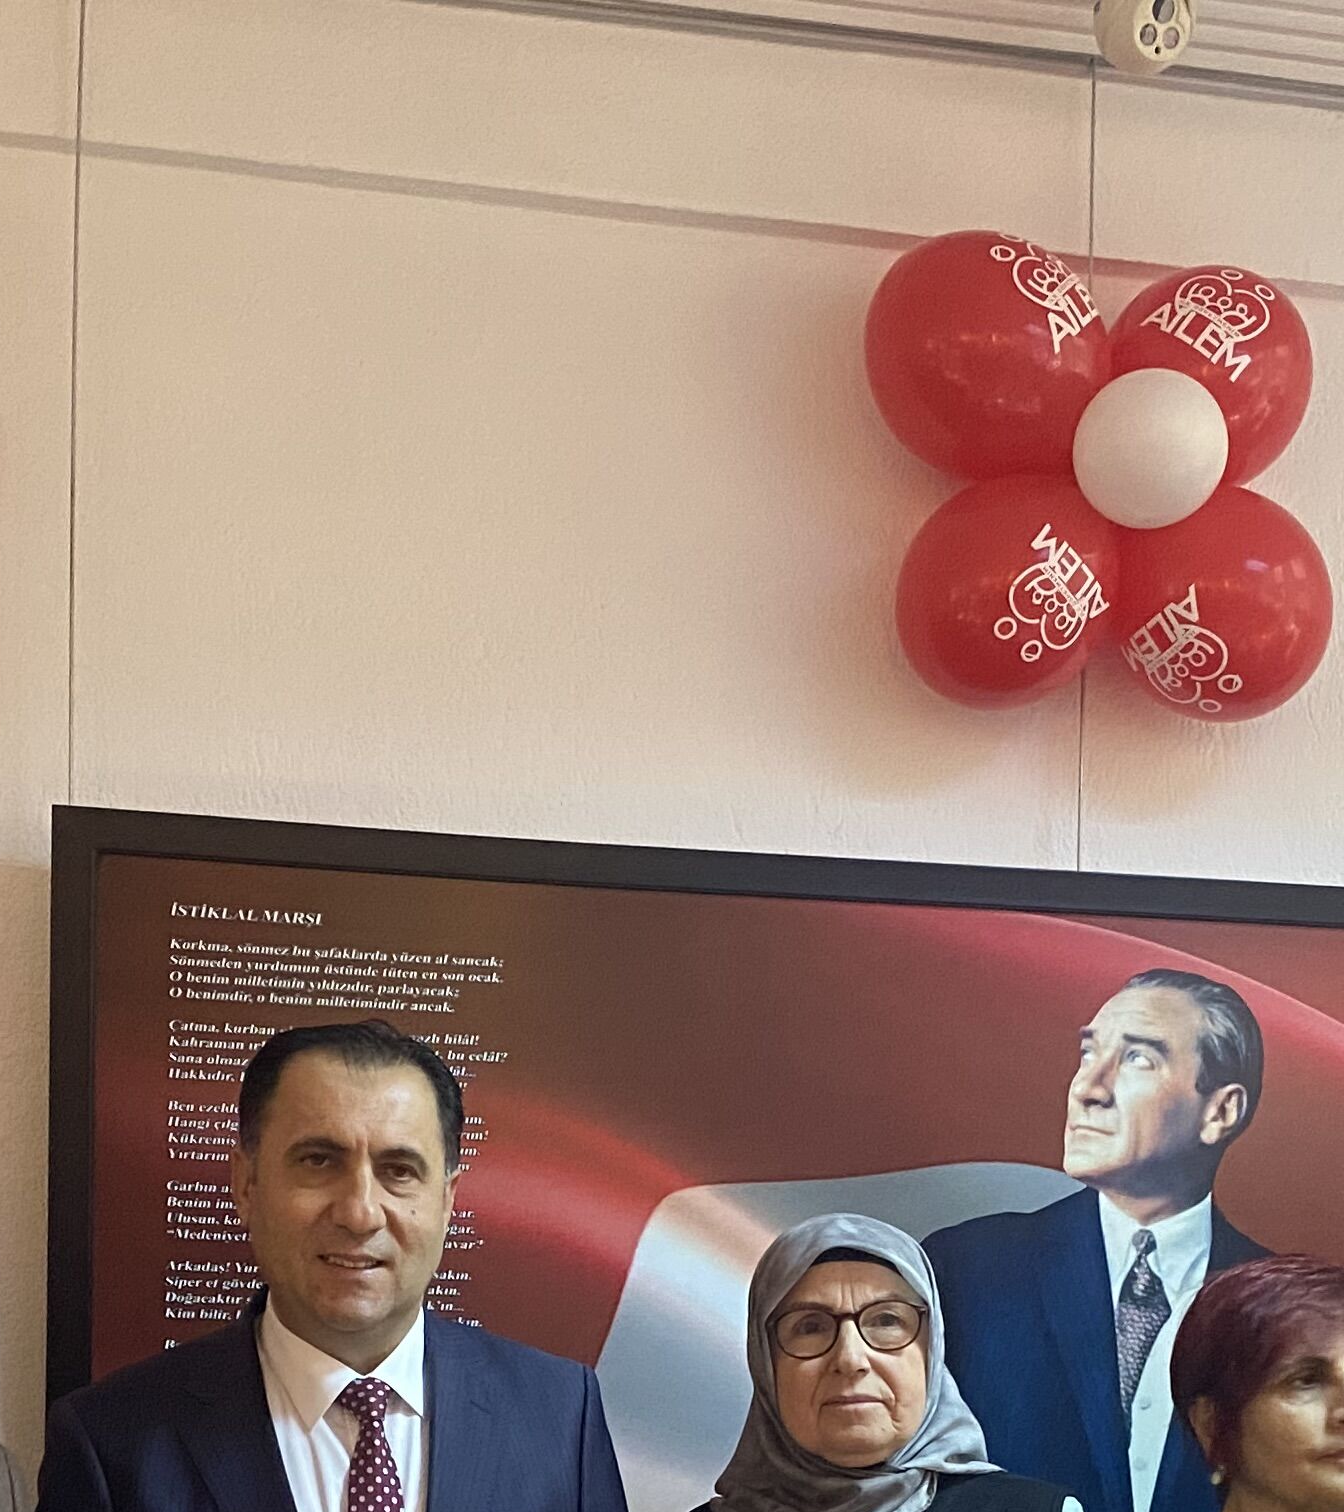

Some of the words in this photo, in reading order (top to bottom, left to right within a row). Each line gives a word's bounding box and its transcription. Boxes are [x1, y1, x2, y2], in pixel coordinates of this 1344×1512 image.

[262, 909, 323, 928] MARŞI
[236, 943, 290, 956] sönmez
[292, 945, 310, 957] bu
[314, 945, 387, 962] şafaklarda
[391, 951, 431, 963] yüzen
[435, 954, 449, 965] al
[169, 954, 242, 969] Sönmeden
[245, 960, 320, 973] yurdumun
[324, 963, 379, 977] üstünde
[382, 968, 418, 979] tüten
[421, 971, 438, 980] en
[442, 972, 465, 982] son
[169, 970, 183, 982] O
[186, 972, 230, 984] benim
[234, 974, 305, 989] milletimin
[169, 986, 183, 998] O
[256, 994, 265, 1003] o
[269, 992, 312, 1005] benim
[316, 995, 408, 1010] milletimindir
[224, 1022, 275, 1036] kurban
[169, 1035, 244, 1051] Kahraman
[447, 1050, 465, 1061] bu
[168, 1051, 203, 1064] Sana
[206, 1054, 249, 1066] olmaz
[168, 1100, 194, 1112] Ben
[168, 1116, 210, 1130] Hangi
[214, 1118, 239, 1132] çılg
[168, 1147, 230, 1161] Yırtarım
[166, 1180, 217, 1194] Garbın
[166, 1196, 211, 1209] Benim
[166, 1260, 231, 1275] Arkadaş!
[165, 1276, 203, 1290] Siper
[205, 1279, 219, 1289] et
[165, 1291, 243, 1305] Doğacaktır
[165, 1307, 196, 1320] Kim
